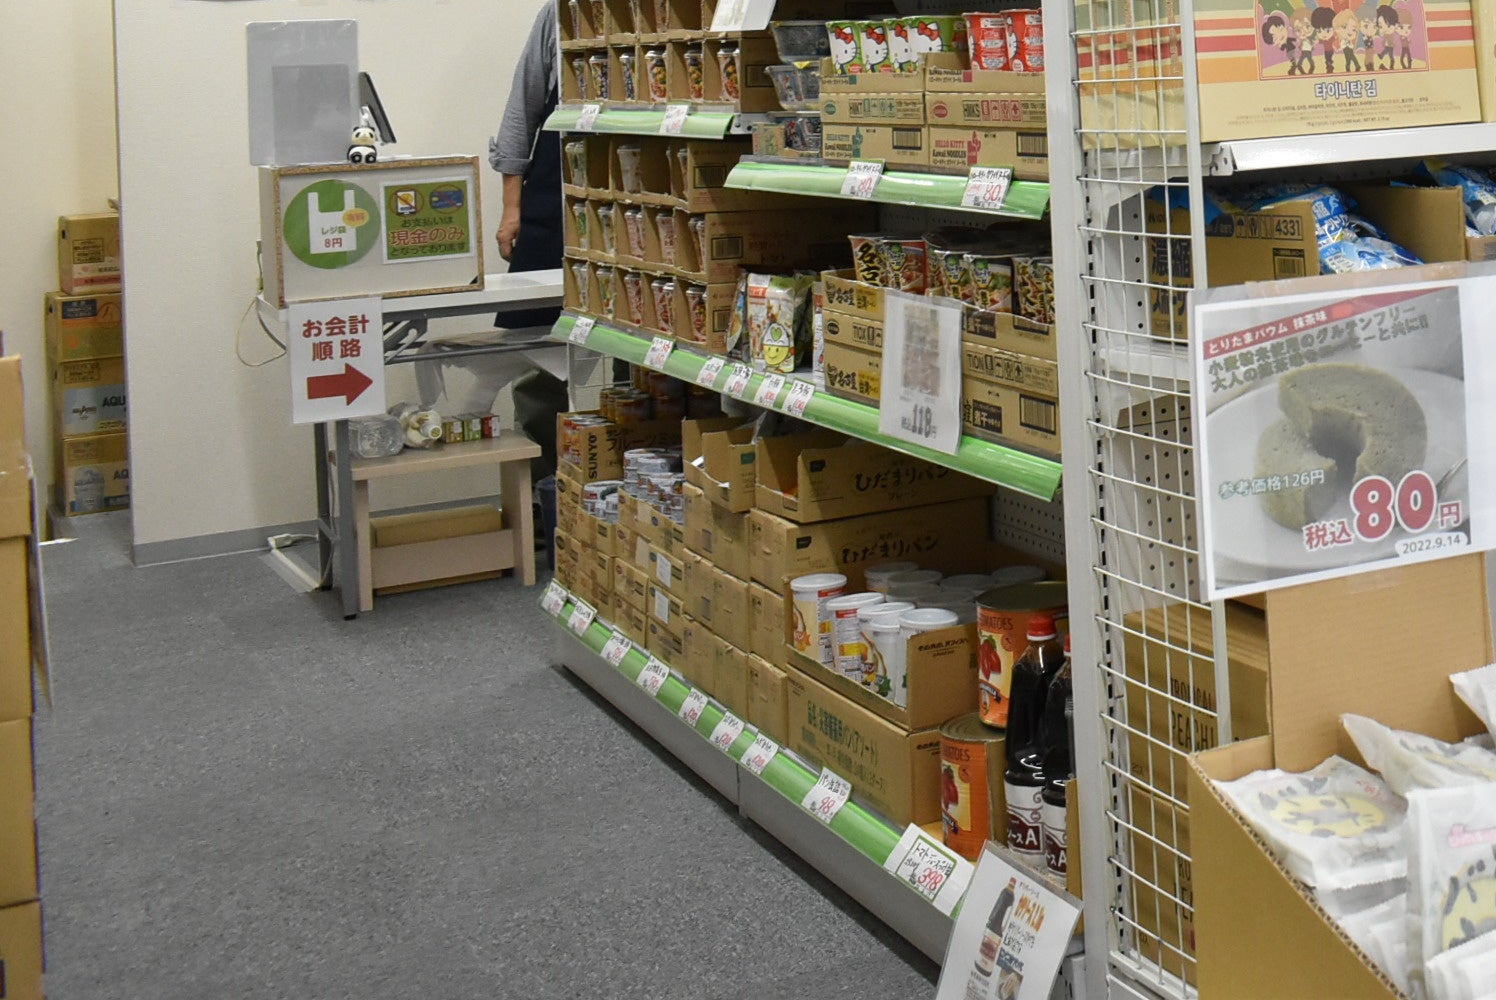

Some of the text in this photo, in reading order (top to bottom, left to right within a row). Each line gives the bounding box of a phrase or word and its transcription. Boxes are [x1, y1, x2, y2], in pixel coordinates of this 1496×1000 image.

[1314, 80, 1378, 101] 타이니탄 김
[321, 225, 347, 236] レジ袋
[401, 216, 454, 228] お支払いは
[1273, 215, 1303, 237] 4331
[324, 237, 343, 249] 8円
[390, 227, 466, 246] 現金のみ
[301, 315, 371, 339] お会計
[1206, 309, 1328, 355] とりたまバウム 抹茶味
[311, 339, 363, 361] 順路
[588, 433, 599, 480] SUNYO
[855, 463, 951, 492] ひだまりパン
[1218, 469, 1326, 500] 参考価格126円
[1302, 469, 1463, 551] 税込80円
[1401, 534, 1462, 555] 2022.9.14
[820, 797, 835, 815] 98
[917, 867, 944, 891] 398
